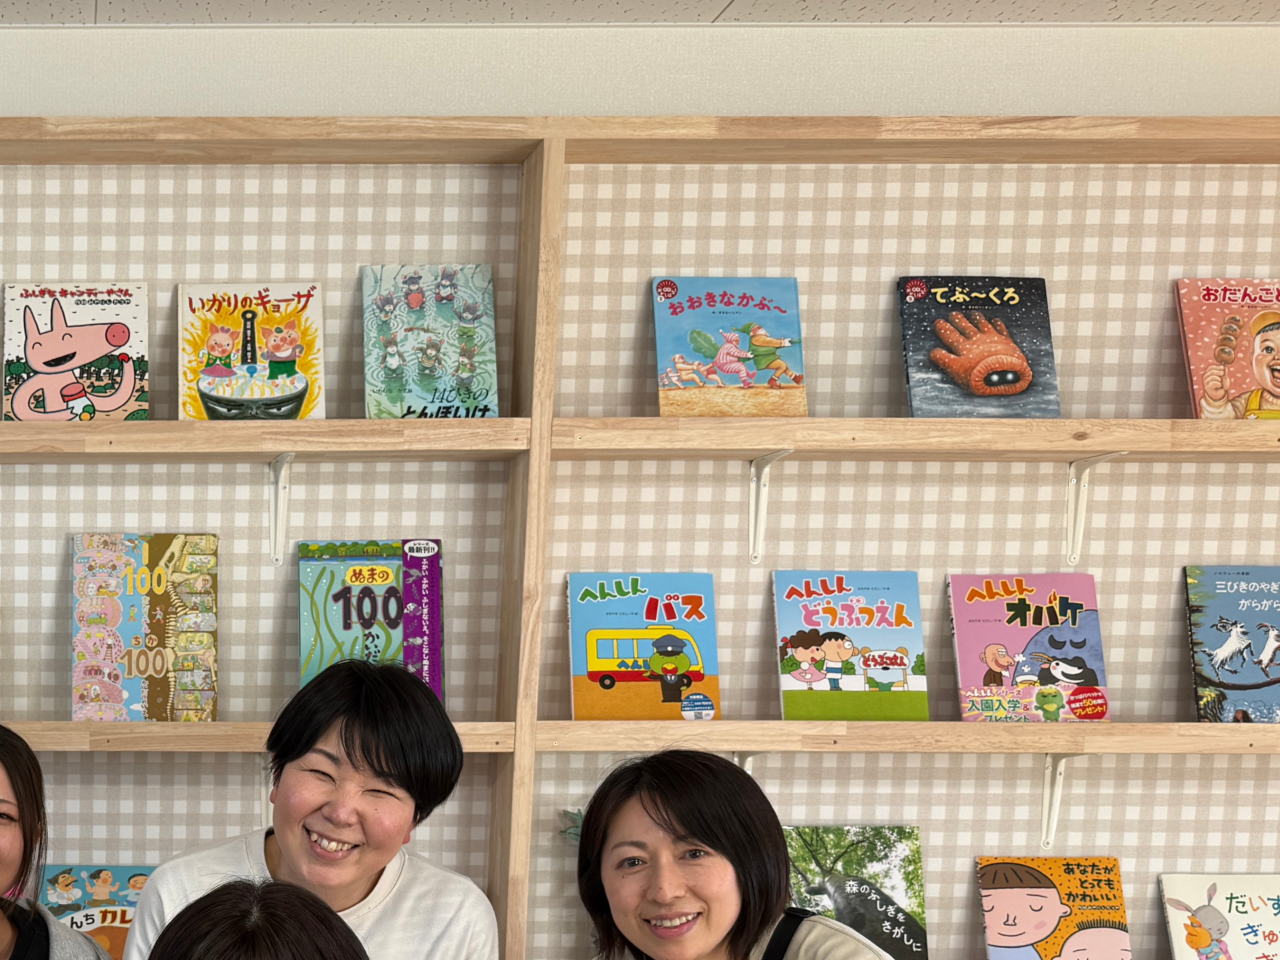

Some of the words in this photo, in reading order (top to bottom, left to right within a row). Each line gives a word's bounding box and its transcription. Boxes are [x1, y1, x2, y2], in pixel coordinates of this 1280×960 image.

[188, 285, 317, 315] いかりのギョーザ
[120, 566, 168, 595] 100
[350, 568, 389, 583] ぬまの
[785, 575, 853, 600] へんしん
[1215, 581, 1280, 593] 三びきのやぎ
[578, 576, 649, 603] へんしん
[966, 577, 1035, 602] へんしん
[332, 585, 404, 631] 100
[643, 593, 708, 622] バス
[801, 597, 914, 628] どうぶつえん
[120, 648, 167, 677] 100
[862, 653, 907, 667] どうぶつえん
[967, 699, 1021, 712] 入園入学
[1062, 862, 1116, 876] あなたが
[1078, 878, 1116, 890] とっても
[845, 881, 906, 923] 森のふしぎを
[1065, 892, 1117, 903] かわいい
[881, 921, 922, 952] さがしに
